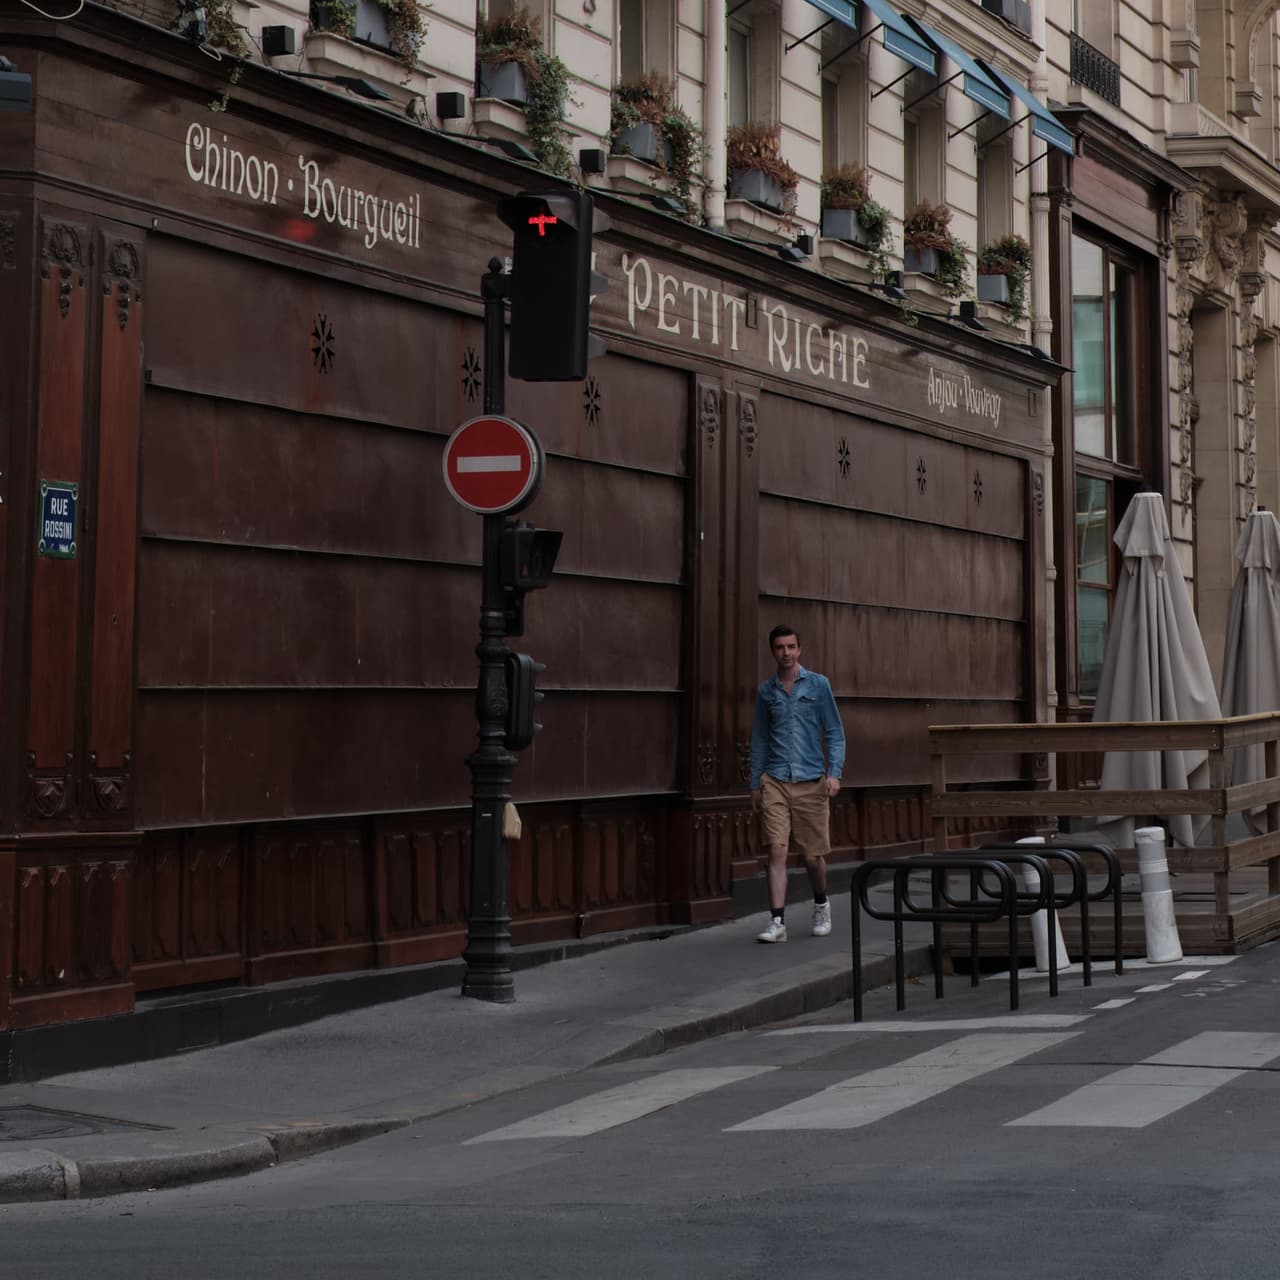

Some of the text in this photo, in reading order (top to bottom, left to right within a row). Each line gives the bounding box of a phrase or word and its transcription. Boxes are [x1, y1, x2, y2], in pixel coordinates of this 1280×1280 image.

[185, 122, 420, 249] Chinon Bourgueil
[622, 253, 746, 351] PETIT
[761, 297, 870, 388] RICHE
[927, 367, 1001, 429] Anjou Vouvray
[44, 520, 73, 540] ROSSINI
[51, 497, 69, 516] RUE
